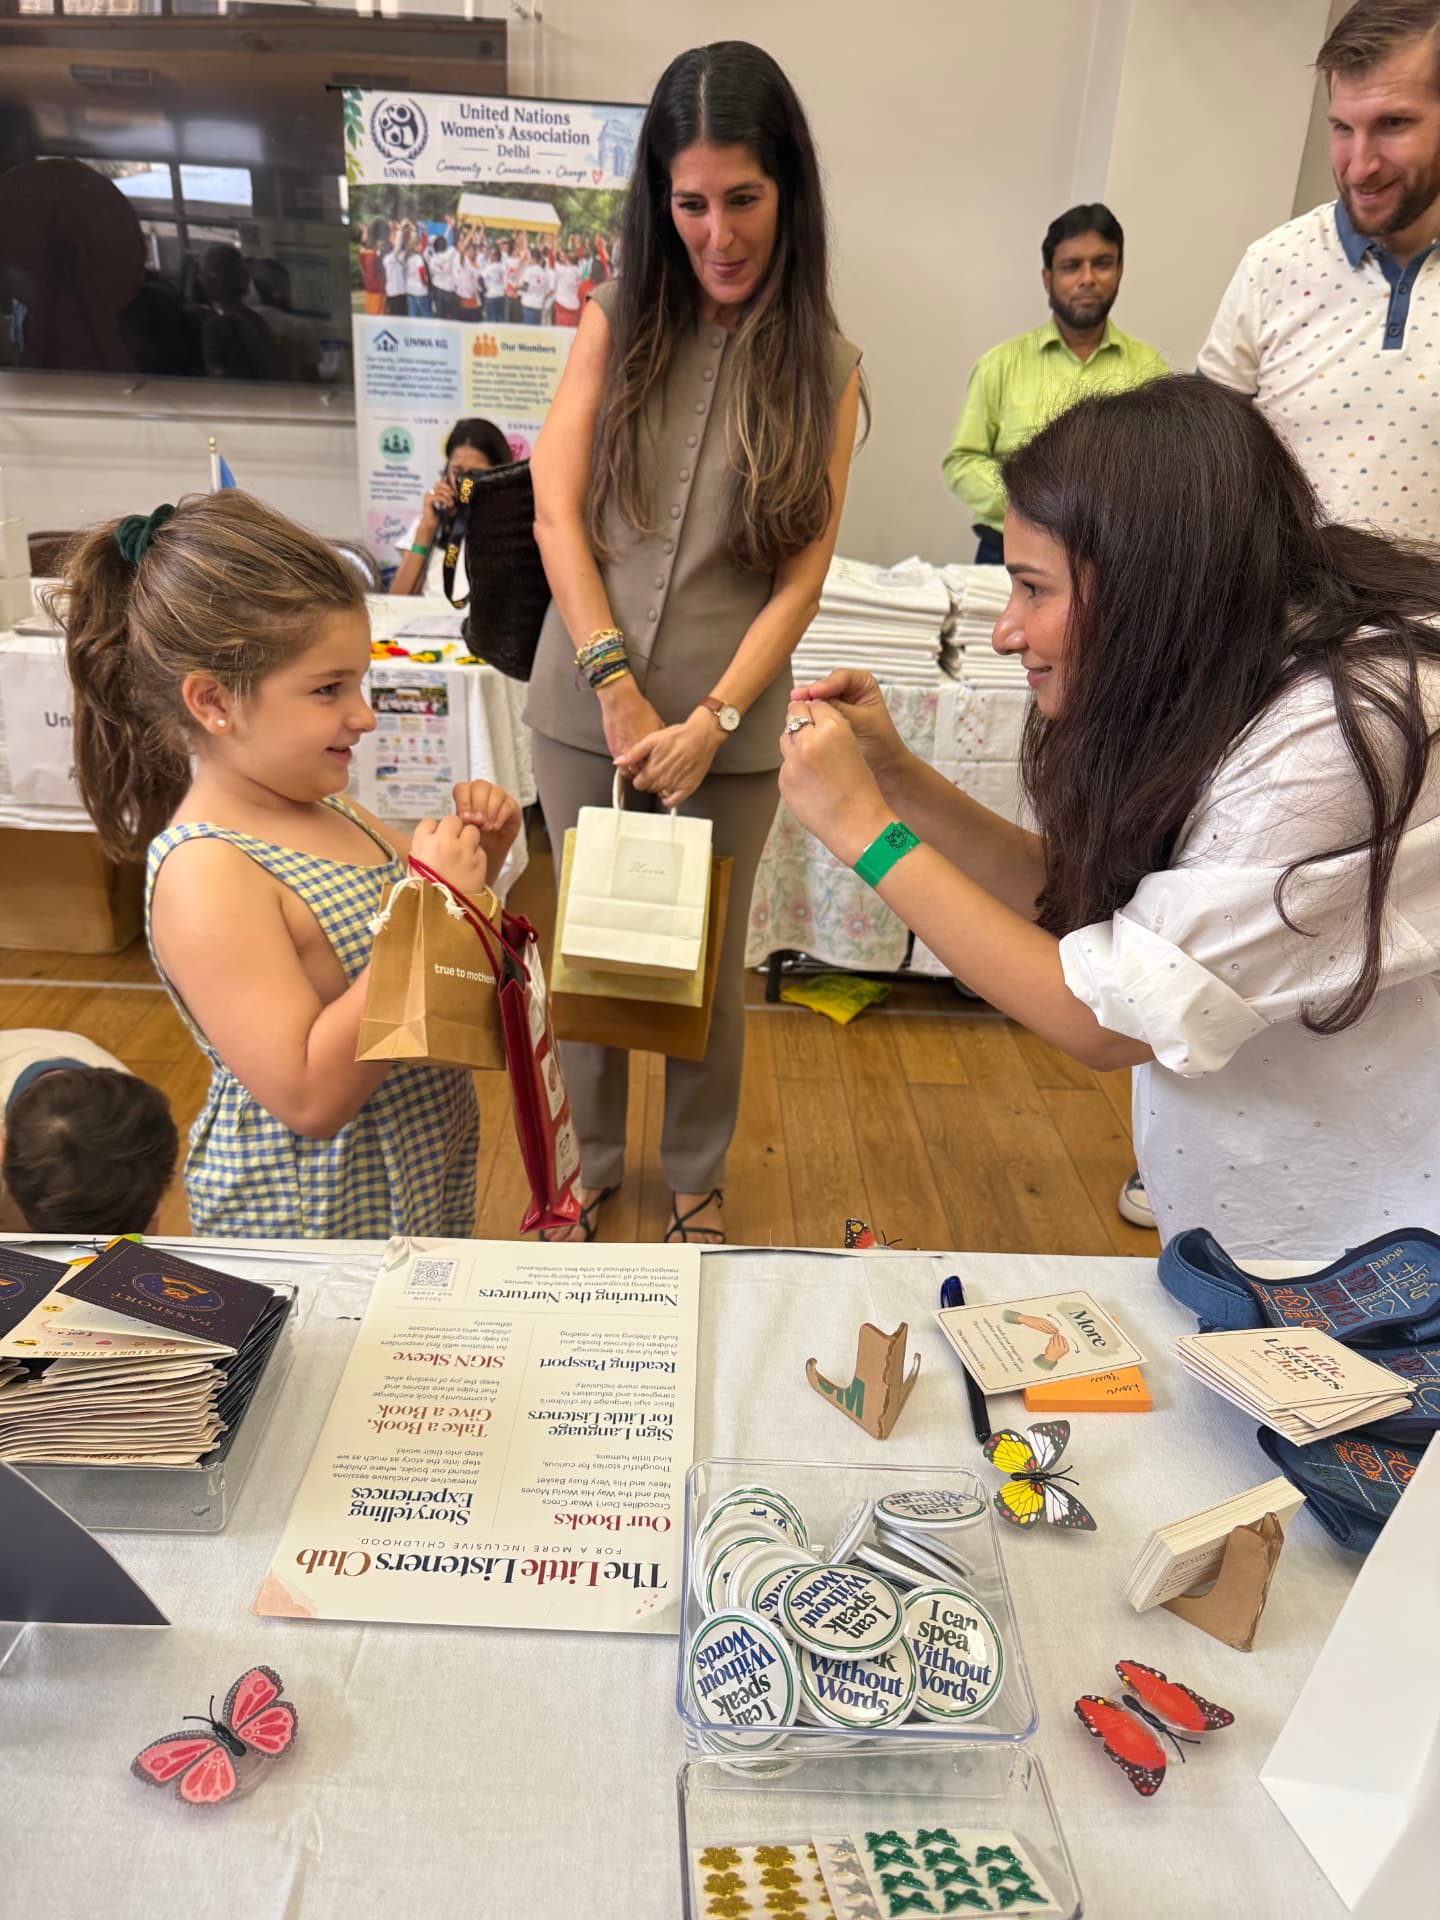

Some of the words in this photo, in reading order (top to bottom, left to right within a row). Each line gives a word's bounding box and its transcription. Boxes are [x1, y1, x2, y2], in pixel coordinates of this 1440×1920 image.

[460, 104, 509, 121] United
[514, 107, 570, 125] Nations
[440, 121, 504, 139] Women's
[509, 126, 590, 145] Association
[497, 144, 530, 158] Delhi
[384, 167, 415, 179] UNWA
[434, 963, 455, 976] true
[456, 967, 465, 978] to
[479, 1289, 560, 1302] Nurturers
[565, 1291, 590, 1303] the
[595, 1290, 677, 1305] Nurturing
[1068, 1310, 1106, 1347] More
[393, 1352, 451, 1365] Sleeve
[454, 1355, 504, 1367] SIGN
[540, 1356, 605, 1370] Passport
[610, 1358, 675, 1372] Reading
[1262, 1348, 1310, 1381] Club
[1263, 1338, 1343, 1390] Listeners
[1294, 1346, 1346, 1379] Little
[377, 1404, 427, 1419] Book
[433, 1406, 444, 1416] a
[448, 1407, 491, 1421] Give
[528, 1411, 599, 1423] Listeners
[603, 1412, 644, 1424] Little
[367, 1417, 422, 1434] Book,
[427, 1421, 438, 1431] a
[648, 1413, 672, 1426] for
[441, 1422, 487, 1437] Take
[548, 1423, 629, 1439] Language
[635, 1425, 672, 1440] Sign
[536, 1477, 565, 1485] Basket
[567, 1477, 588, 1485] Busy
[590, 1478, 610, 1486] Very
[351, 1487, 472, 1507] Experiences
[521, 1487, 549, 1495] Moves
[596, 1489, 615, 1497] Way
[541, 1498, 567, 1506] Crocs
[595, 1500, 620, 1508] Don't
[622, 1501, 670, 1509] Crocodiles
[348, 1501, 469, 1524] Storytelling
[554, 1513, 620, 1530] Books
[626, 1515, 670, 1531] Our
[358, 1537, 445, 1548] CHILDHOOD.
[453, 1542, 525, 1551] INCLUSIVE
[296, 1549, 370, 1576] Club
[376, 1553, 517, 1582] Listeners
[521, 1559, 600, 1586] Little
[604, 1562, 667, 1588] The
[791, 1570, 849, 1610] Words
[800, 1575, 871, 1628] Without
[822, 1591, 876, 1634] speak
[872, 1605, 891, 1620] I
[929, 1600, 941, 1621] I
[943, 1610, 977, 1630] can
[847, 1613, 877, 1638] can
[918, 1621, 970, 1654] spea
[696, 1626, 757, 1670] Words
[697, 1643, 776, 1700] Without
[810, 1651, 904, 1697] Without
[712, 1674, 771, 1718] speak
[815, 1674, 889, 1715] Words
[761, 1697, 777, 1721] I
